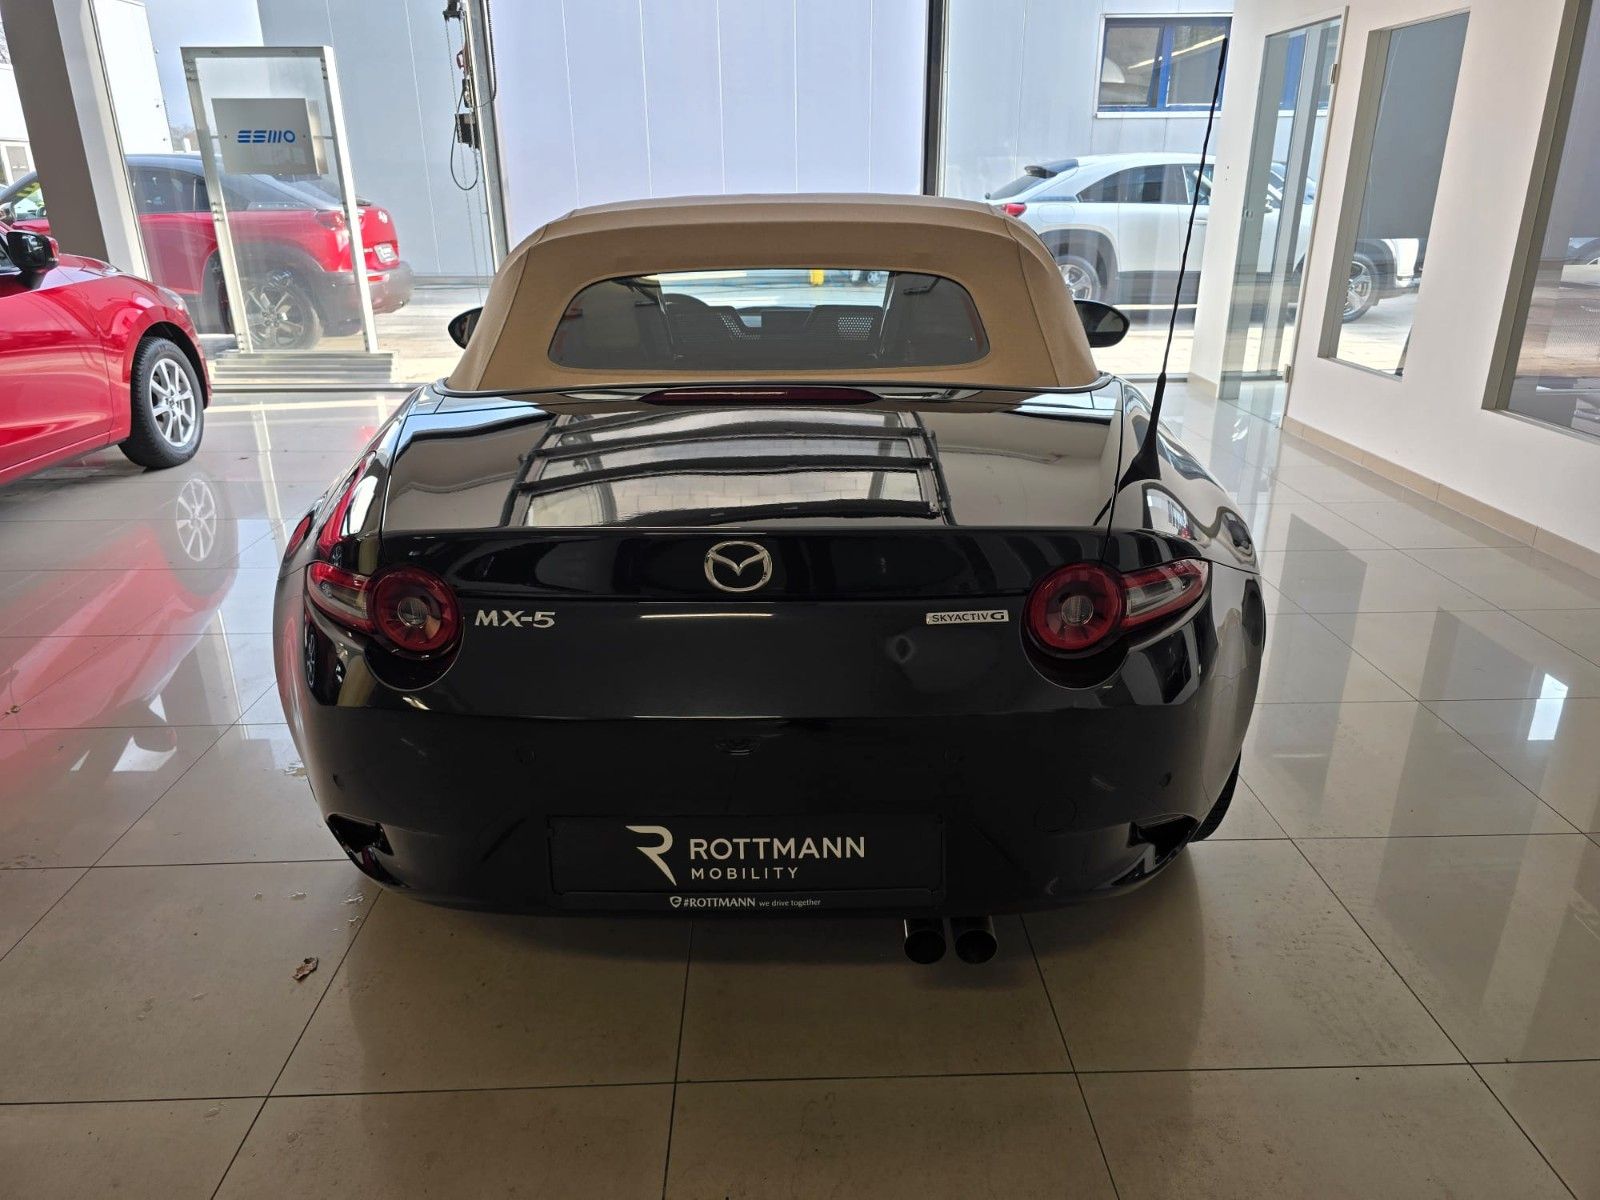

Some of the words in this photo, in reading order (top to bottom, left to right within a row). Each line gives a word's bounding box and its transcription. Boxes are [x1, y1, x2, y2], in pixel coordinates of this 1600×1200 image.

[474, 609, 556, 629] MX-5
[689, 836, 865, 860] ROTTMANN
[691, 867, 799, 880] MOBILITY
[683, 897, 756, 908] #ROTTMANN
[771, 898, 790, 907] drive
[791, 898, 822, 908] together
